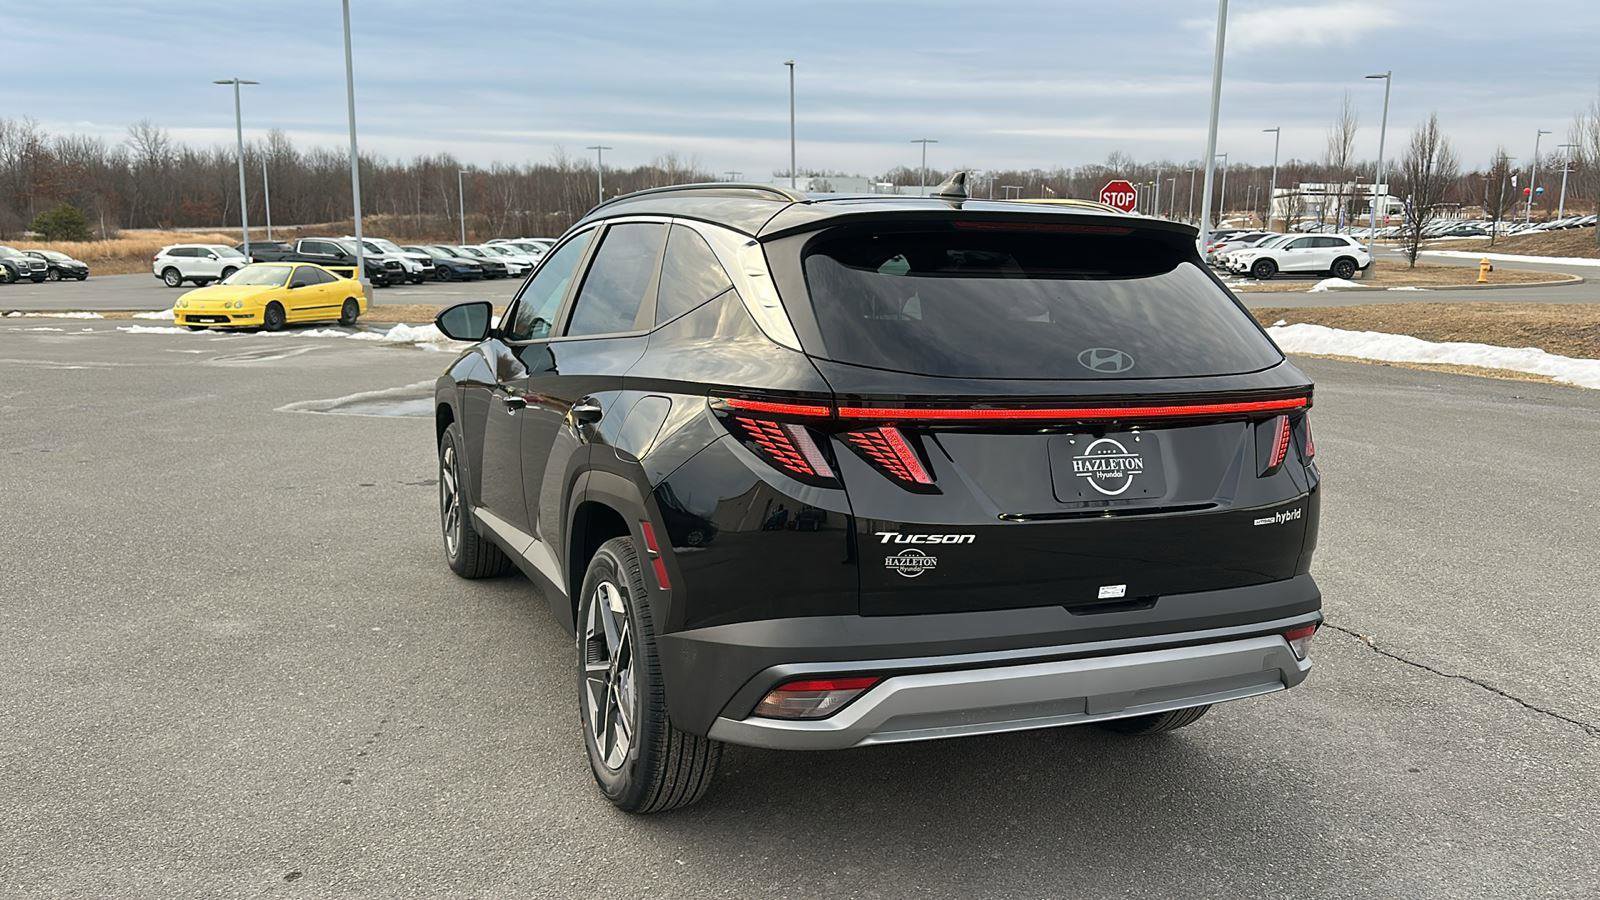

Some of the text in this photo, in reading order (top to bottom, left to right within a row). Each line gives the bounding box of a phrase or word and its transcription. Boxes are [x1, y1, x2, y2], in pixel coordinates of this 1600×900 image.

[1102, 192, 1134, 206] STOP
[1072, 458, 1143, 472] HAZLETON
[1096, 470, 1123, 480] Hyundai
[1275, 508, 1301, 524] hybrid
[885, 557, 938, 566] HAZLETON
